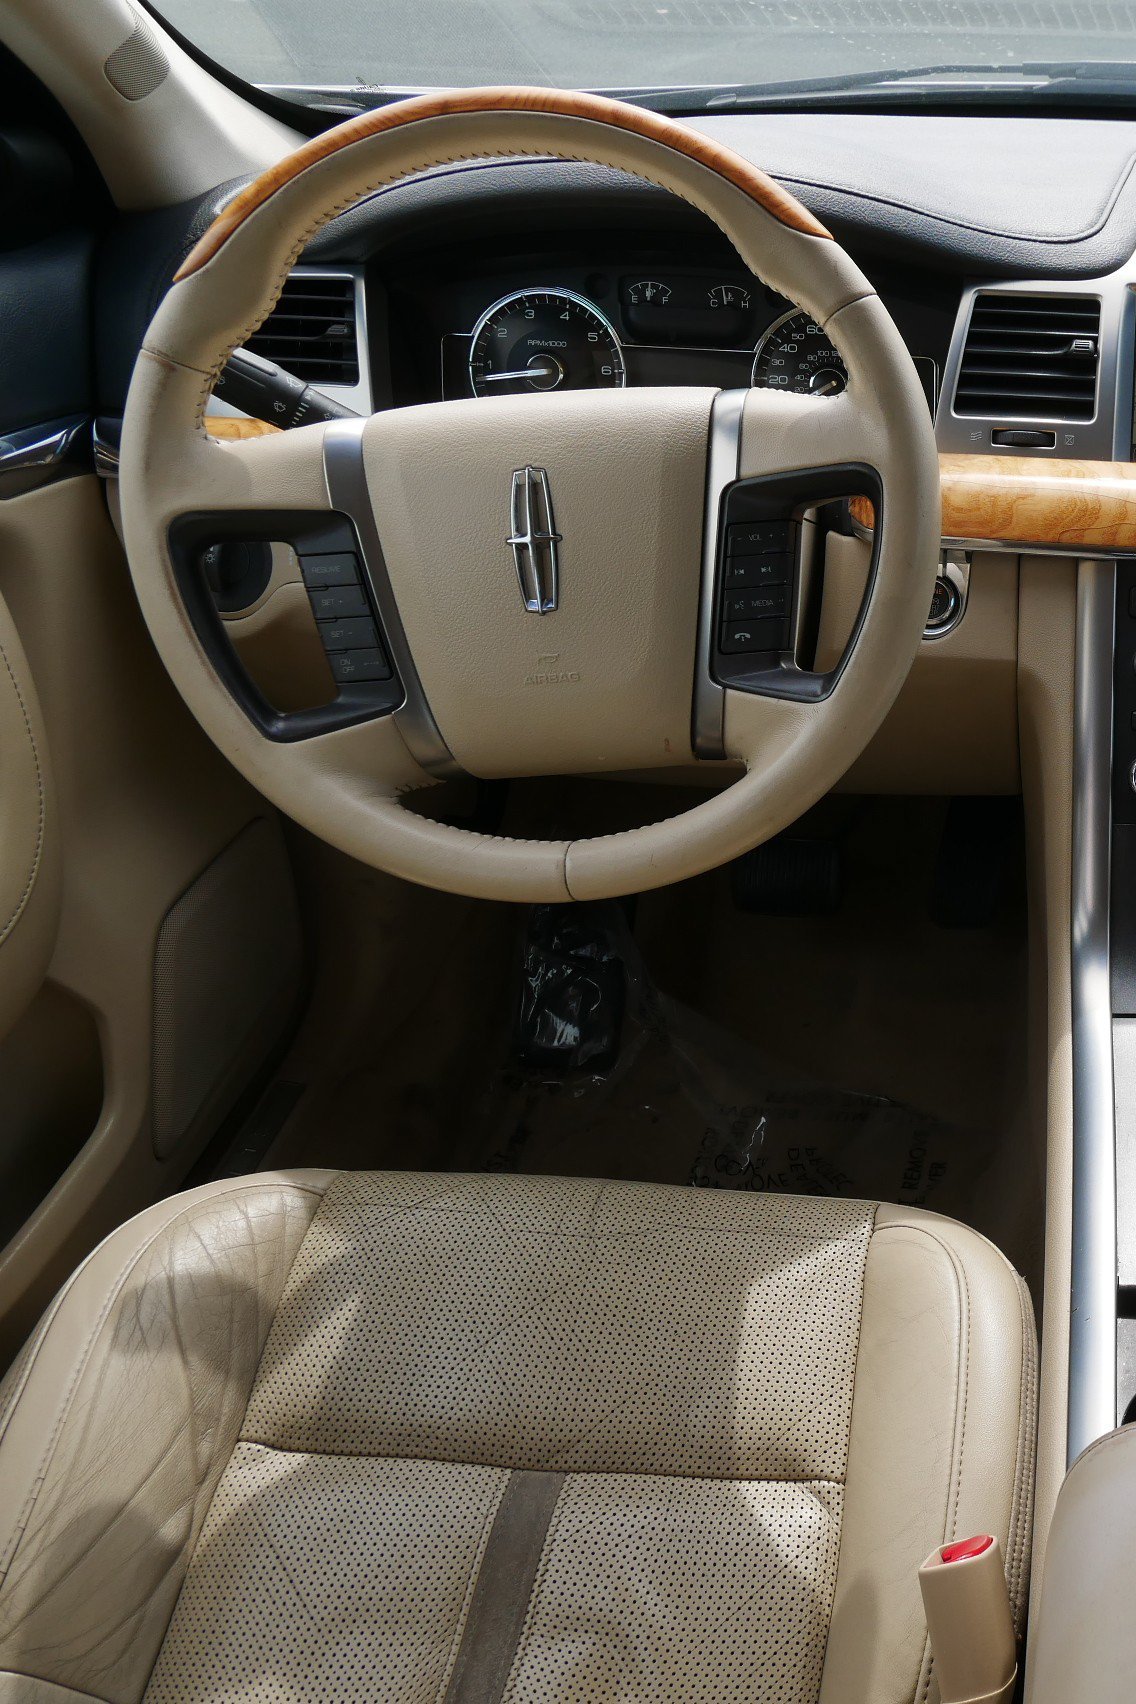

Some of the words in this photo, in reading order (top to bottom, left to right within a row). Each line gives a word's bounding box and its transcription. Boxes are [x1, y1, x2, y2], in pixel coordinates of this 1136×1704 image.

[710, 299, 718, 308] C
[741, 300, 749, 309] H
[525, 309, 535, 319] 3
[559, 311, 570, 321] 4
[497, 328, 508, 338] 2
[806, 325, 825, 335] 60
[587, 332, 598, 342] 5
[527, 339, 567, 349] RPMx1000
[779, 344, 797, 353] 40
[487, 360, 492, 369] 1
[601, 365, 612, 376] 6
[769, 375, 788, 384] 20
[312, 566, 341, 574] RESUME
[751, 599, 774, 607] MEDIA
[524, 673, 580, 685] AIRBAG
